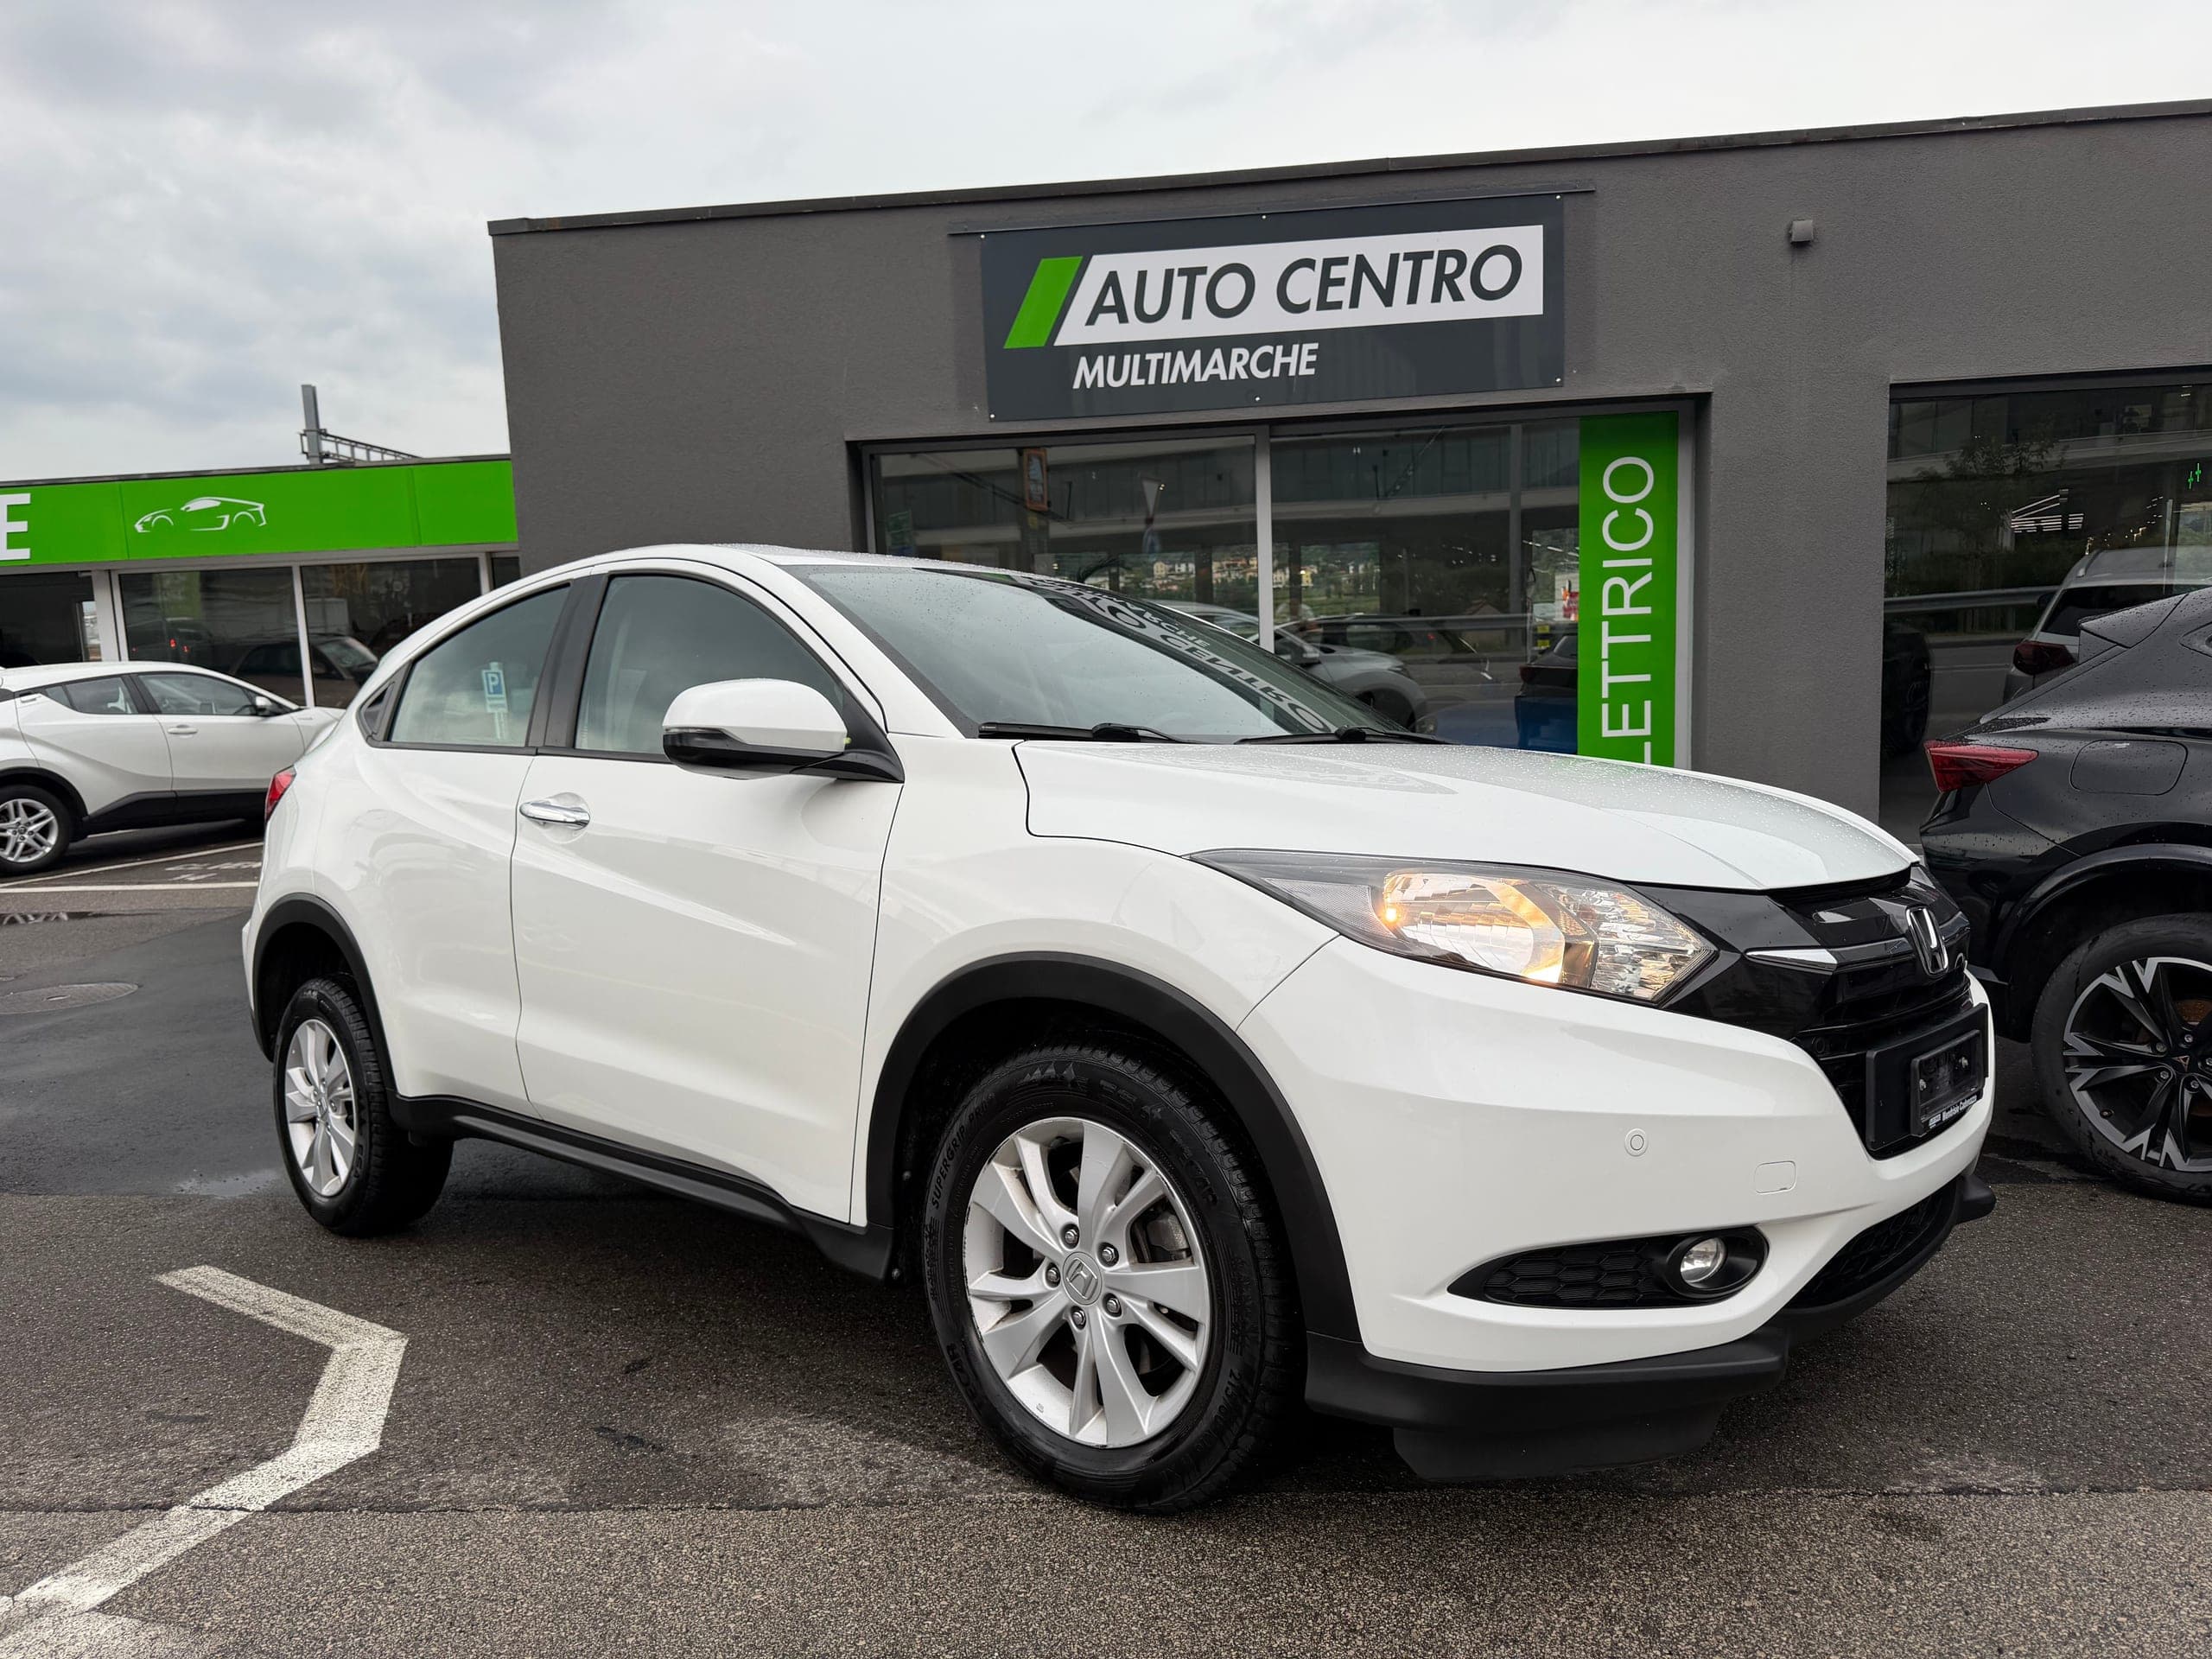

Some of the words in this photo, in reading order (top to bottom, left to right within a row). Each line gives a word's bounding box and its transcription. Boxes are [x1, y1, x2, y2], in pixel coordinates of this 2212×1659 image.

[1085, 263, 1255, 326] AUTO
[1277, 245, 1522, 314] CENTRO
[1073, 343, 1319, 389] MULTIMARCHE
[0, 493, 30, 560] E
[1602, 457, 1654, 765] ETTRICO
[487, 673, 499, 694] P
[931, 1124, 966, 1210] SUPERGRIP
